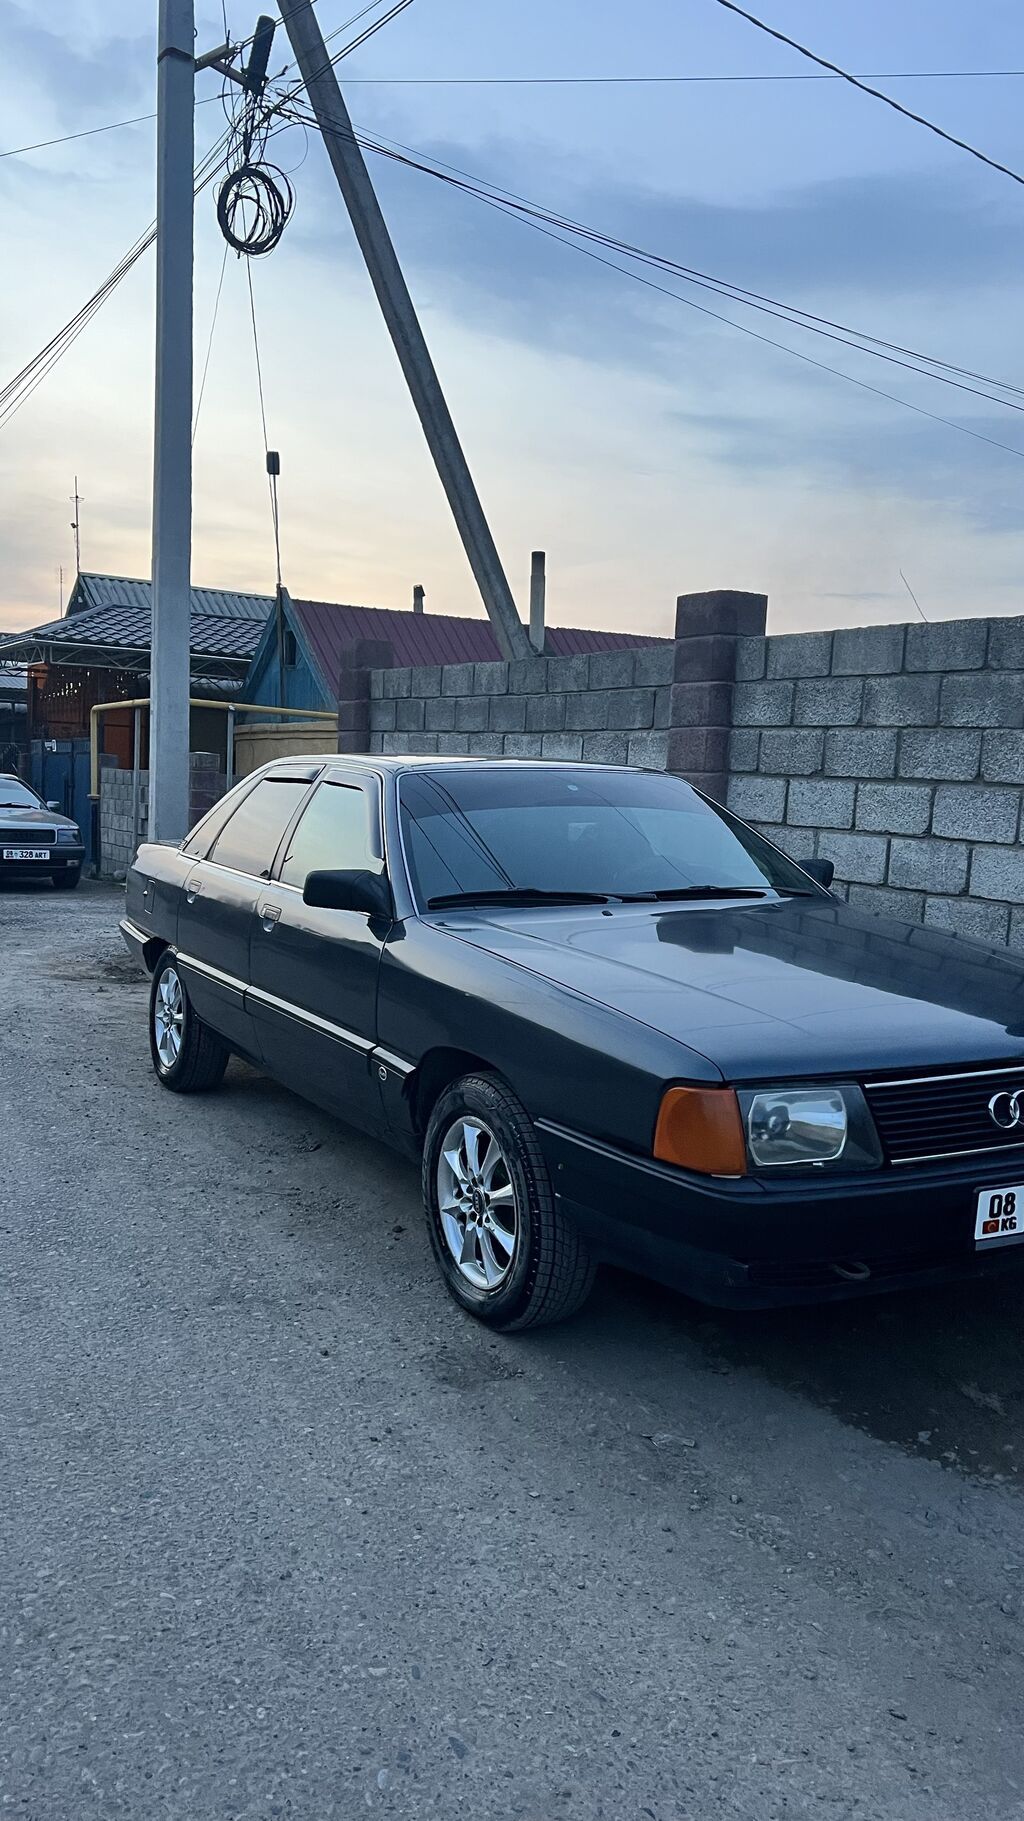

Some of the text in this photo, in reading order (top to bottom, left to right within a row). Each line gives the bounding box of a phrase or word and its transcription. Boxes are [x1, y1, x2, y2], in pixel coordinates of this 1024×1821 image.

[19, 850, 33, 858] 328
[989, 1192, 1016, 1218] 08
[1001, 1216, 1017, 1231] KG
